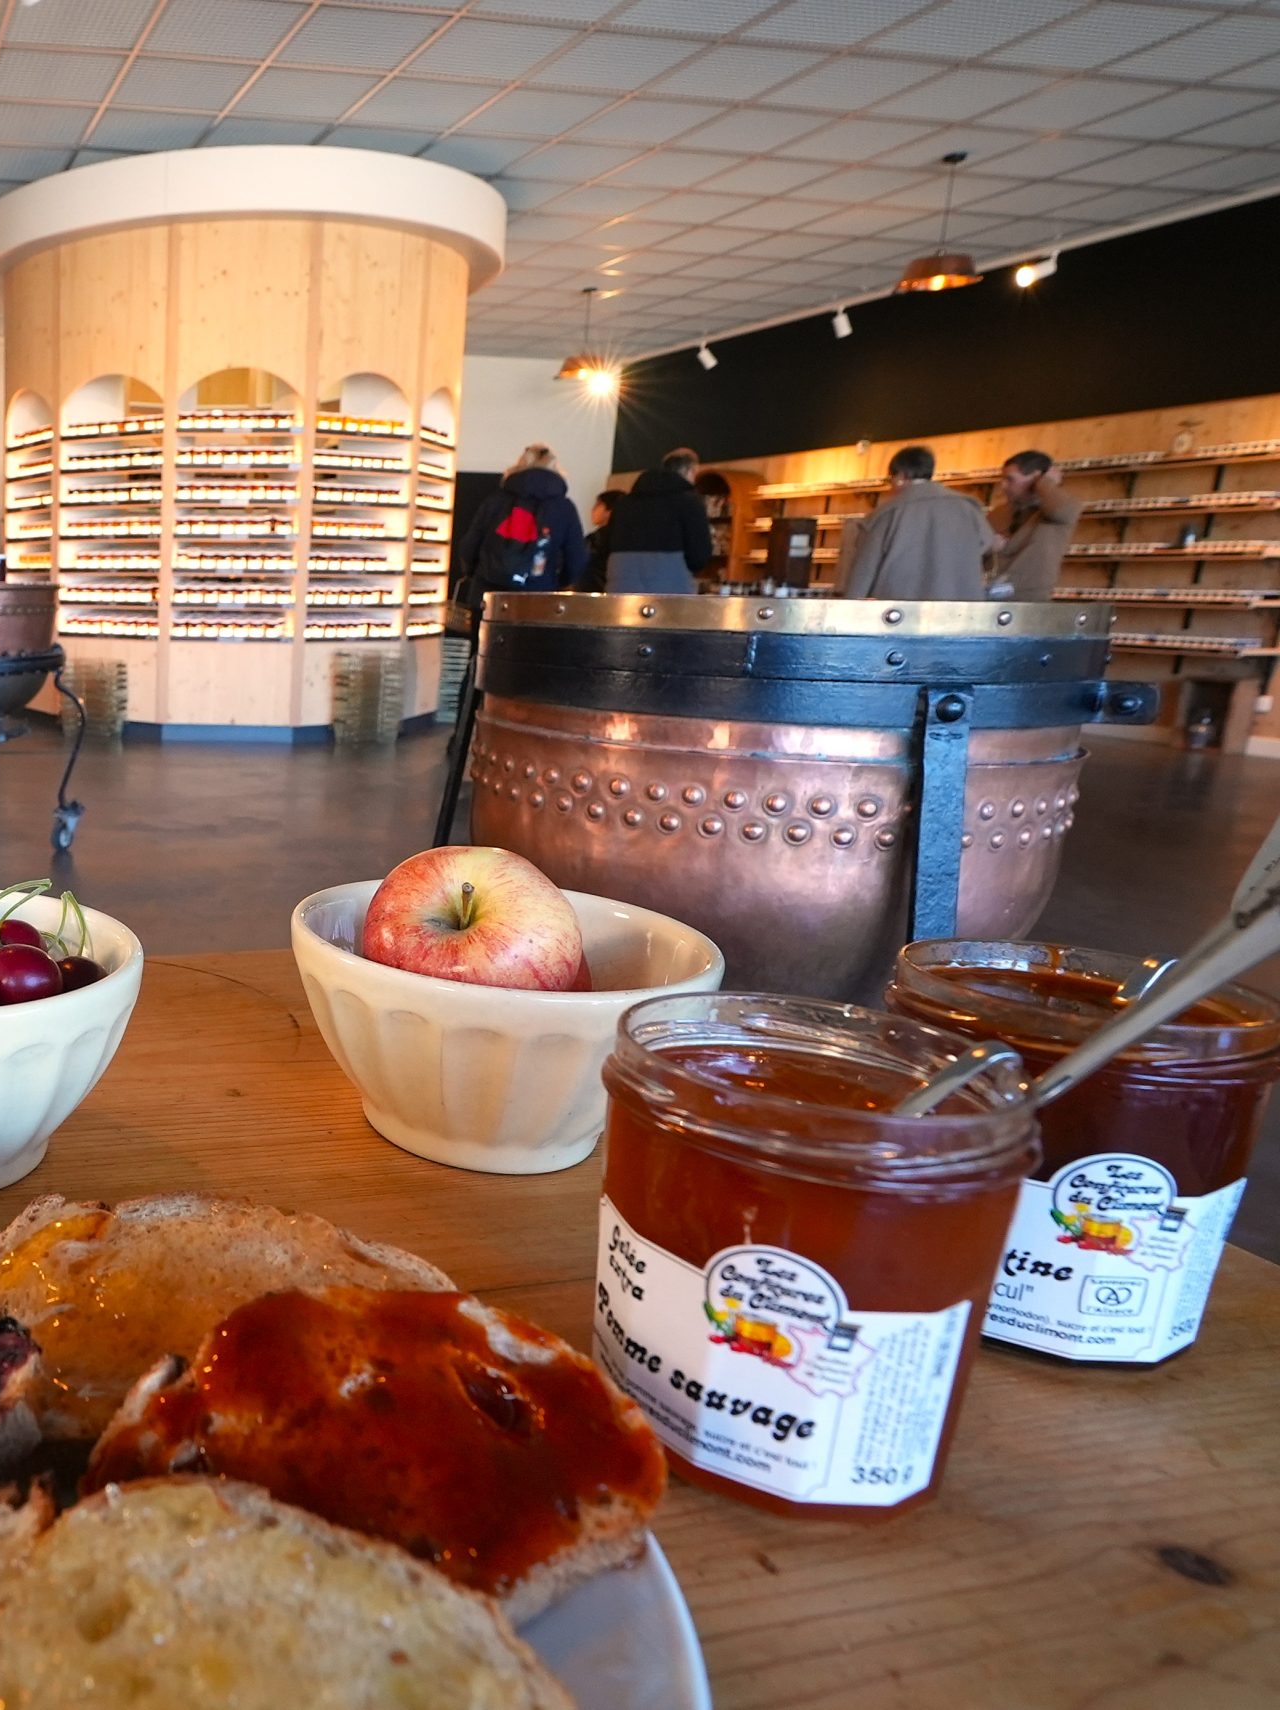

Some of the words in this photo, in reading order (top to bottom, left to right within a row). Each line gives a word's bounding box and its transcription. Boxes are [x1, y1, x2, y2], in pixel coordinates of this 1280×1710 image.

[755, 1257, 798, 1281] Les
[1003, 1249, 1074, 1281] tine
[720, 1264, 826, 1305] Confitures
[598, 1281, 663, 1374] Pomme
[669, 1369, 816, 1442] sauvage
[850, 1465, 899, 1485] 350
